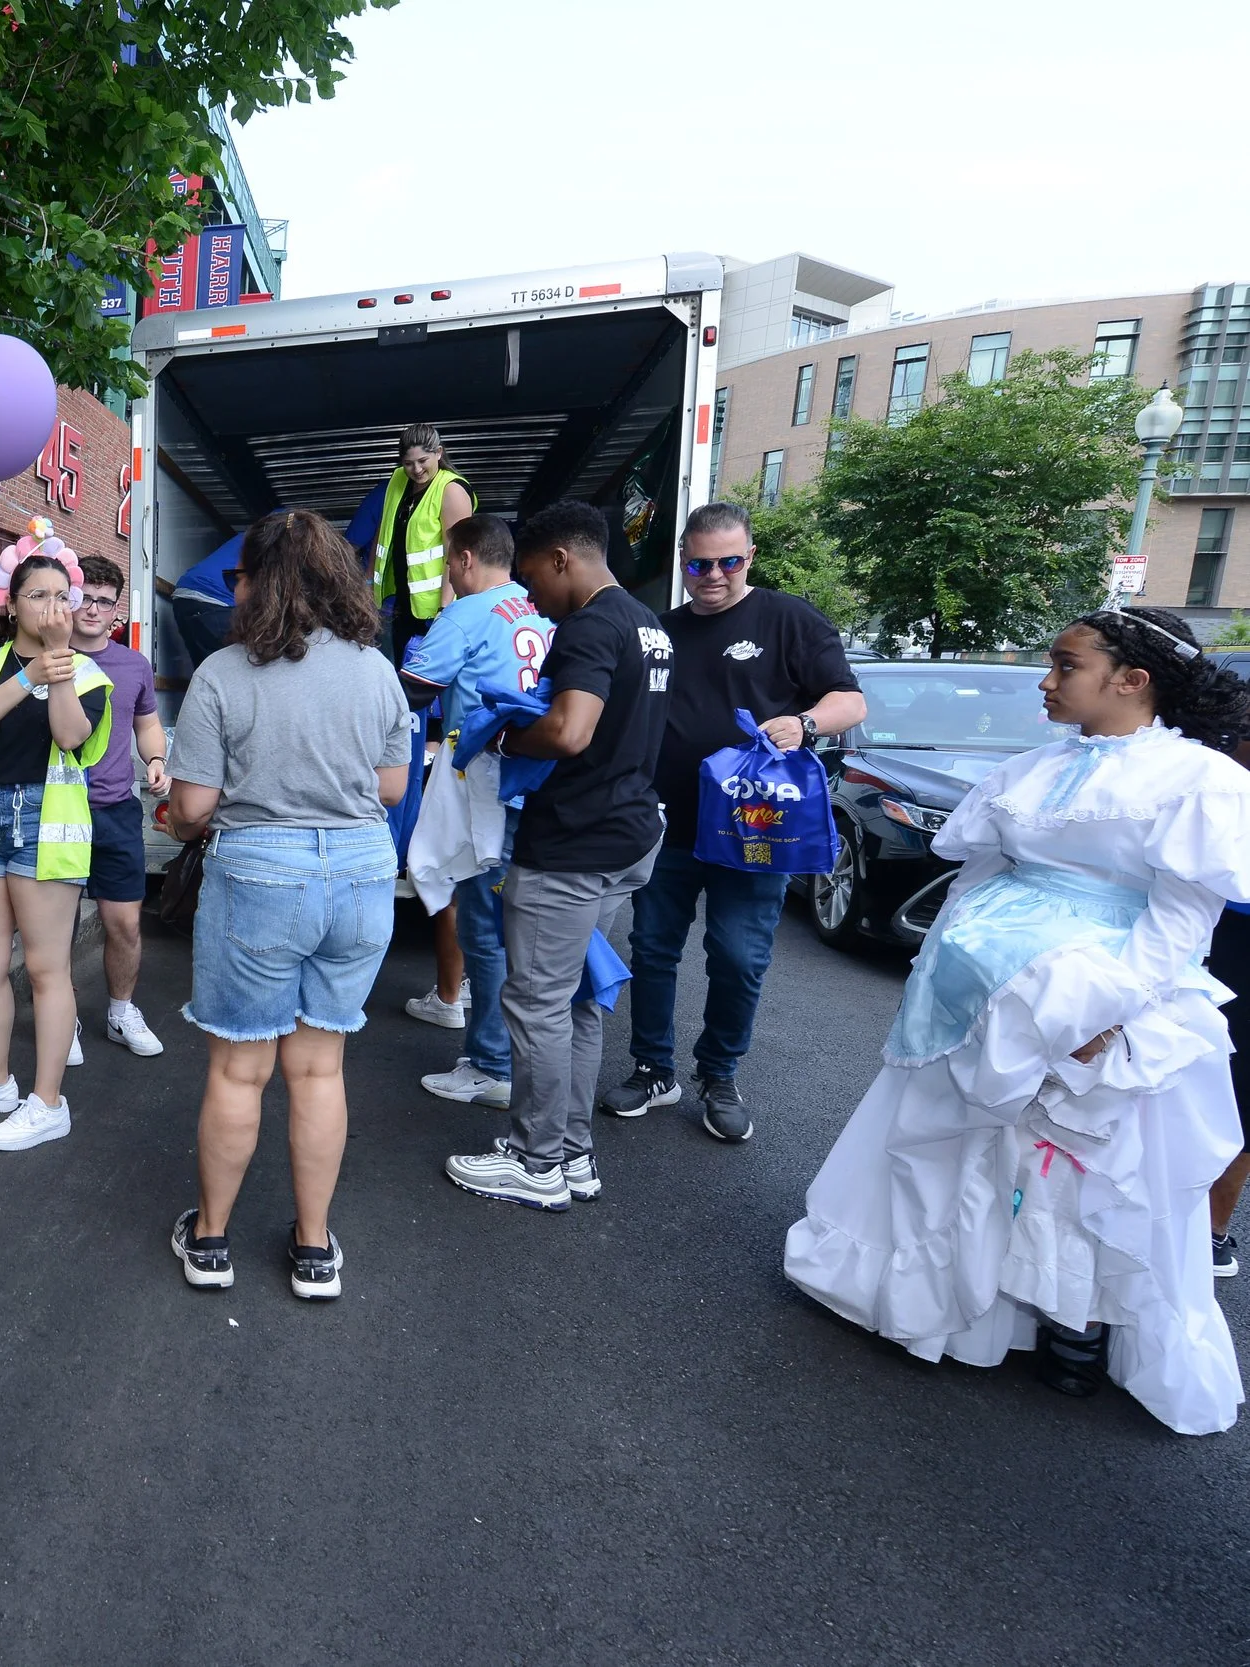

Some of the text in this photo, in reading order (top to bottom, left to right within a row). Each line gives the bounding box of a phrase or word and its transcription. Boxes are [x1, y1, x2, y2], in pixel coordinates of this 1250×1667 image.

[158, 243, 184, 308] UTH
[209, 235, 232, 307] HARR
[94, 298, 122, 309] 937
[511, 285, 575, 304] TT 5634 D
[36, 416, 85, 513] 45
[721, 775, 801, 802] GOYA
[732, 806, 784, 825] cares
